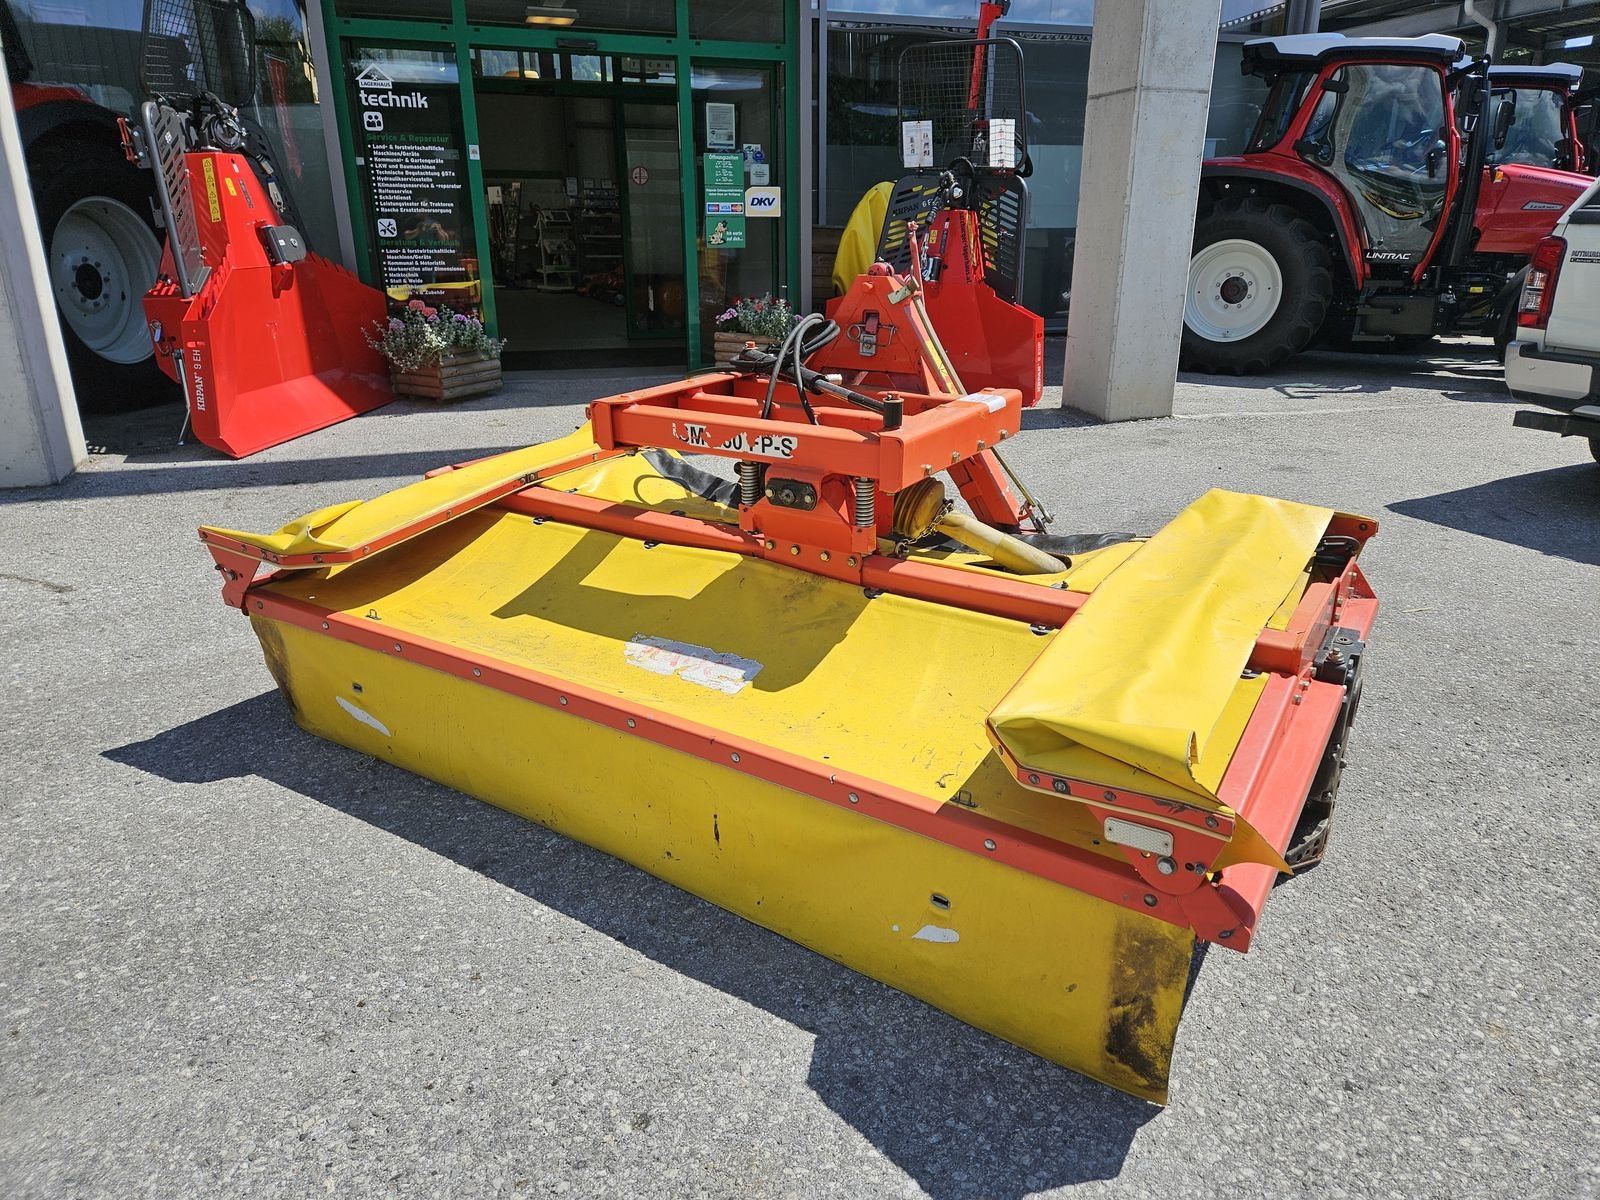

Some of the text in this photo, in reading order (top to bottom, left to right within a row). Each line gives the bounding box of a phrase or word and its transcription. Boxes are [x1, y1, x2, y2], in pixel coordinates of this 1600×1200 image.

[359, 90, 428, 108] technik
[751, 198, 775, 206] DKV
[893, 204, 920, 216] KRPAN
[1366, 252, 1411, 260] LINTRAC
[192, 350, 201, 361] EH
[195, 375, 205, 411] KRPAN
